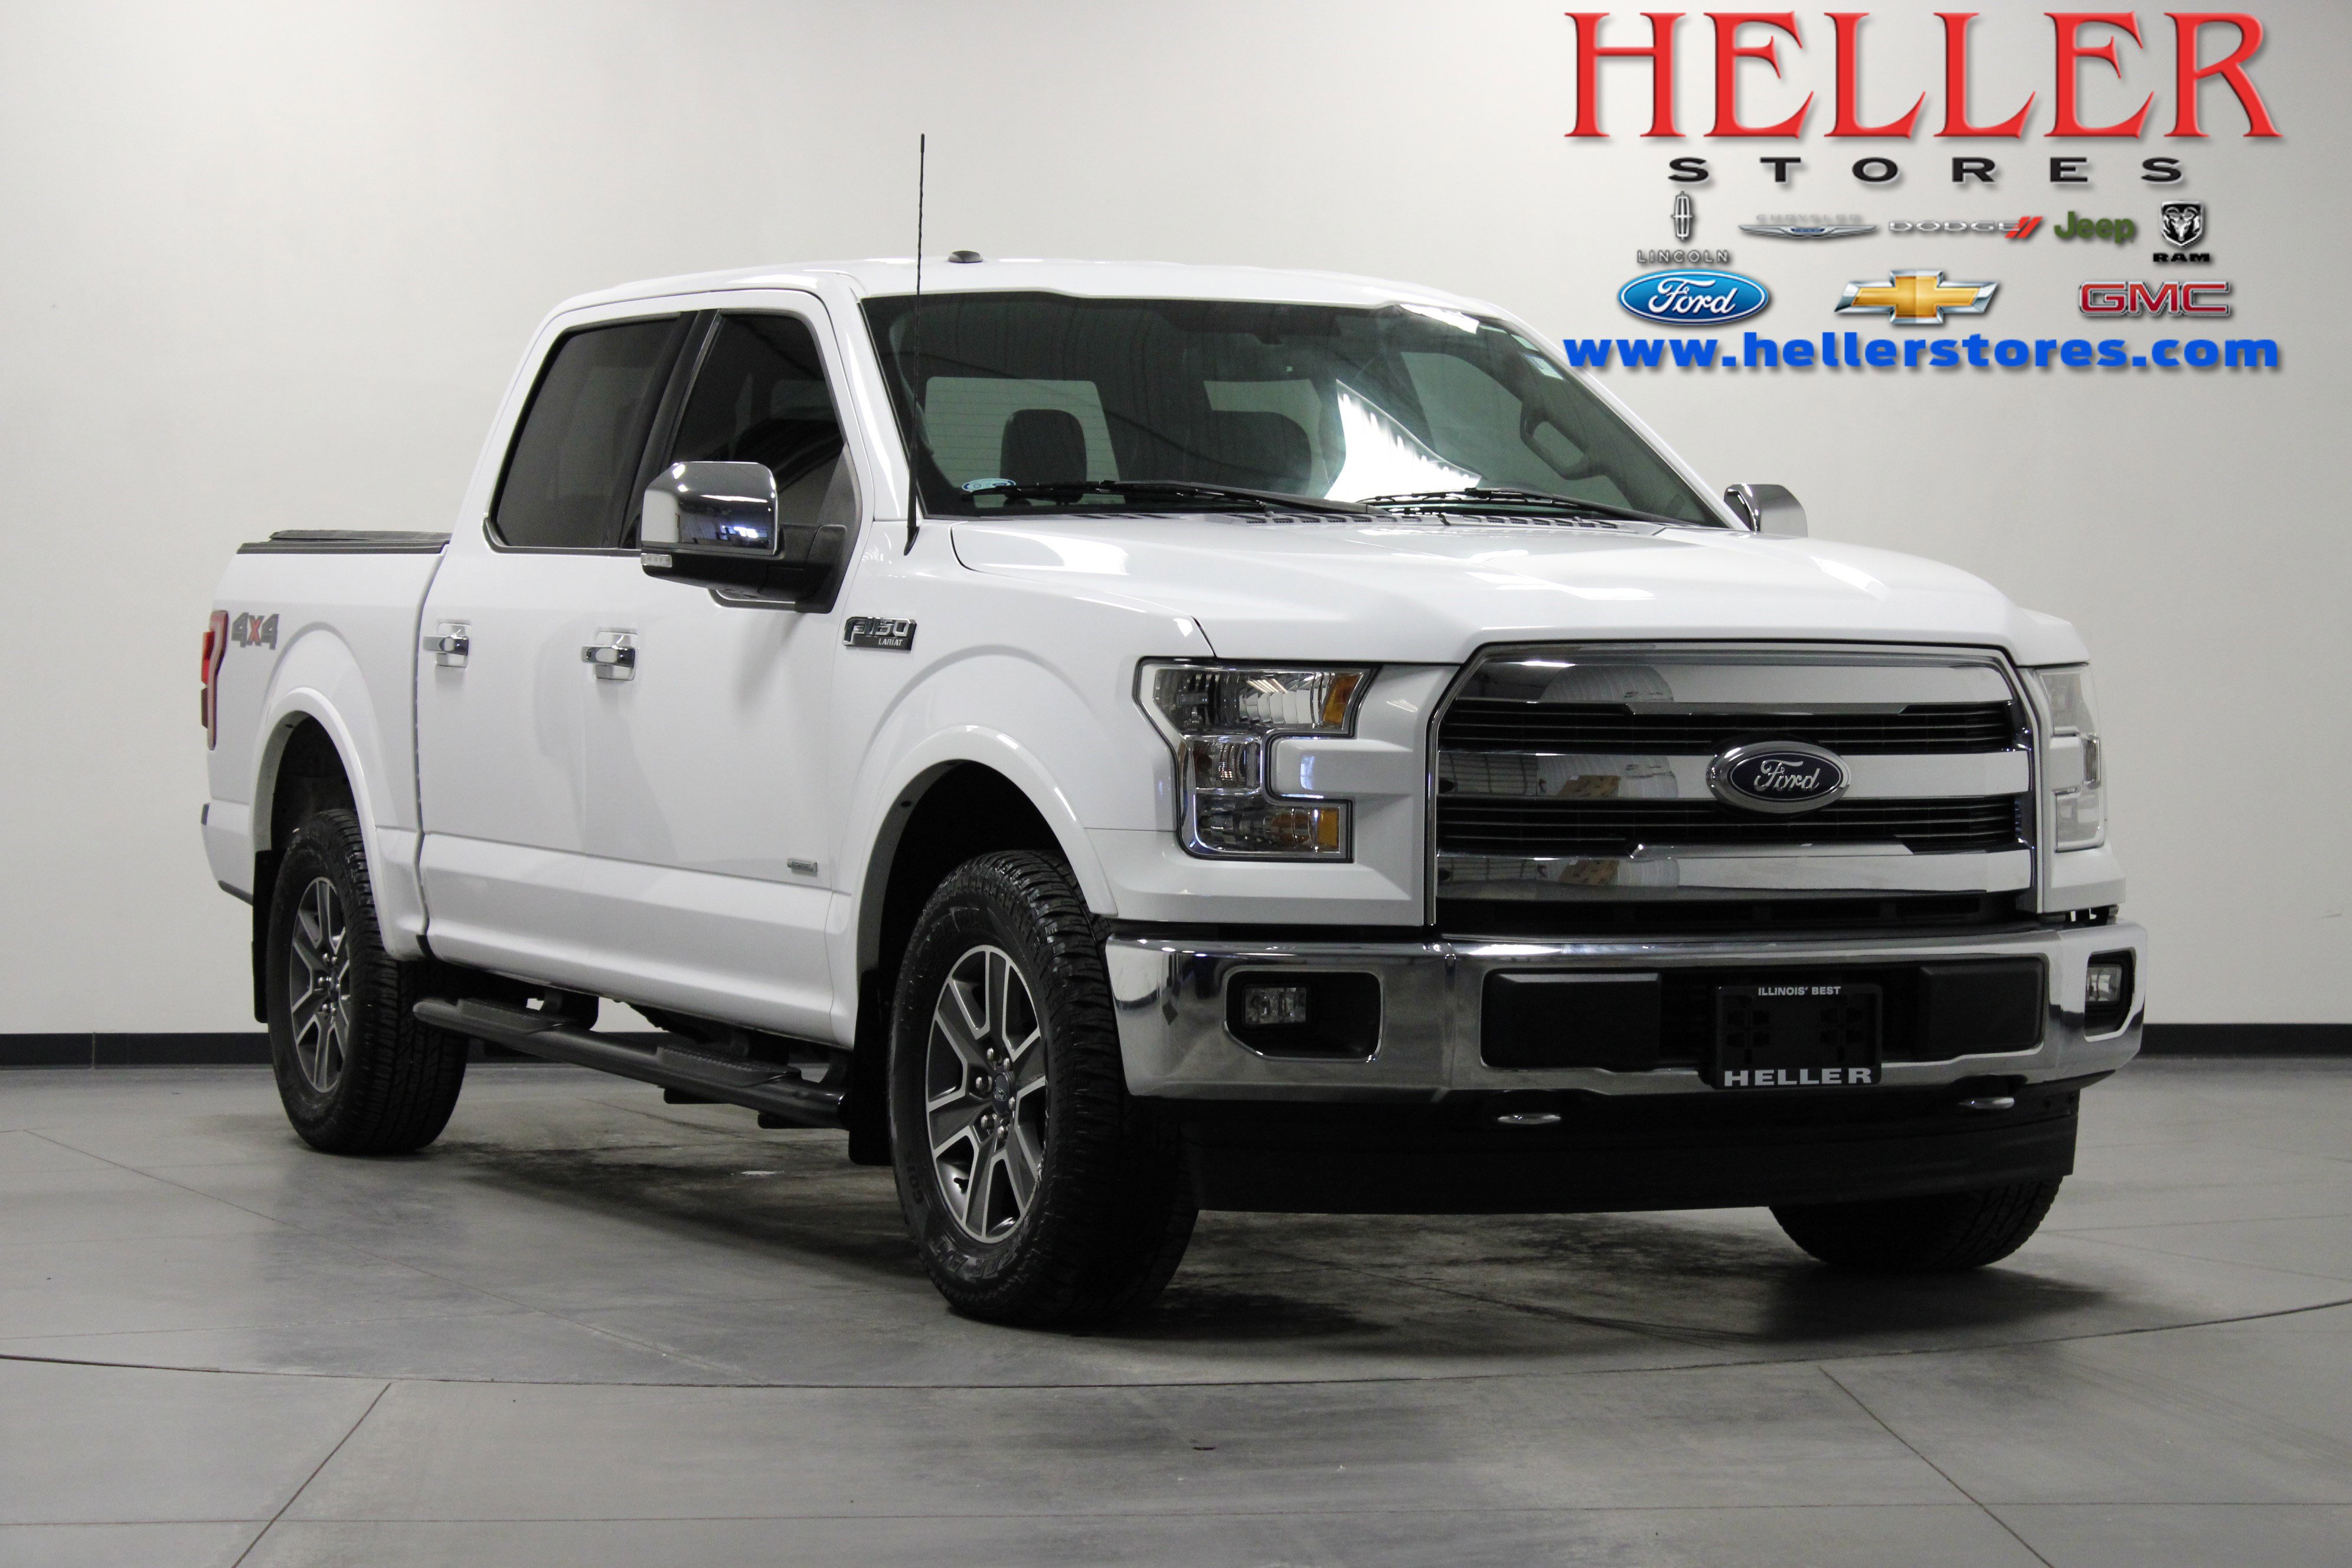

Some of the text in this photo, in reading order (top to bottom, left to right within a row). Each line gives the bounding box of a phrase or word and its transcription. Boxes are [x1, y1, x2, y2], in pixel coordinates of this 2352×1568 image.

[878, 638, 903, 646] LARIAT
[1753, 759, 1821, 792] Ford
[1758, 986, 1841, 996] ILLINOIS' BEST
[1724, 1067, 1871, 1087] HELLER
